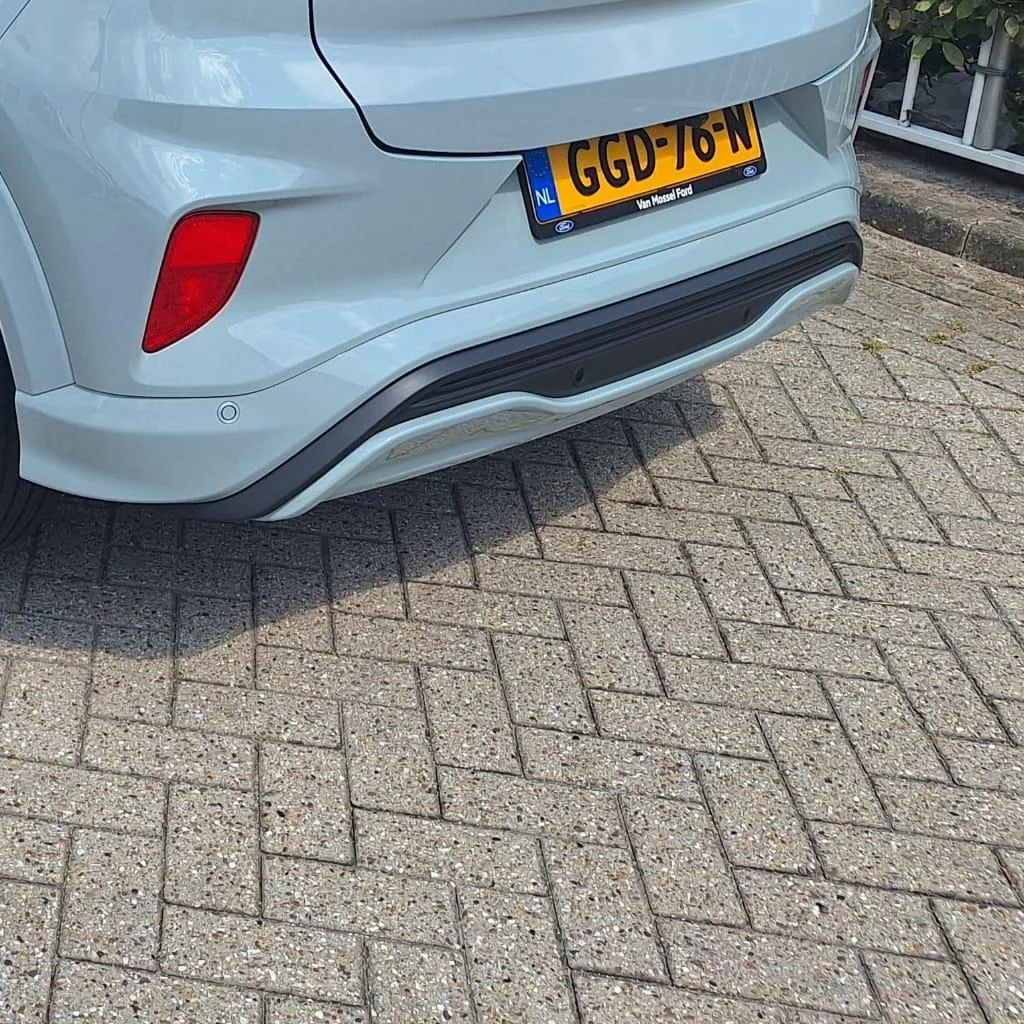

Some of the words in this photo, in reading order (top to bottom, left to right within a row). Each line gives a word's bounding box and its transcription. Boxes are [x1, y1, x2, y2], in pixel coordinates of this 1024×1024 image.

[535, 187, 556, 207] NL
[636, 197, 651, 210] Van
[651, 190, 676, 207] Mossel
[676, 184, 693, 200] Ford
